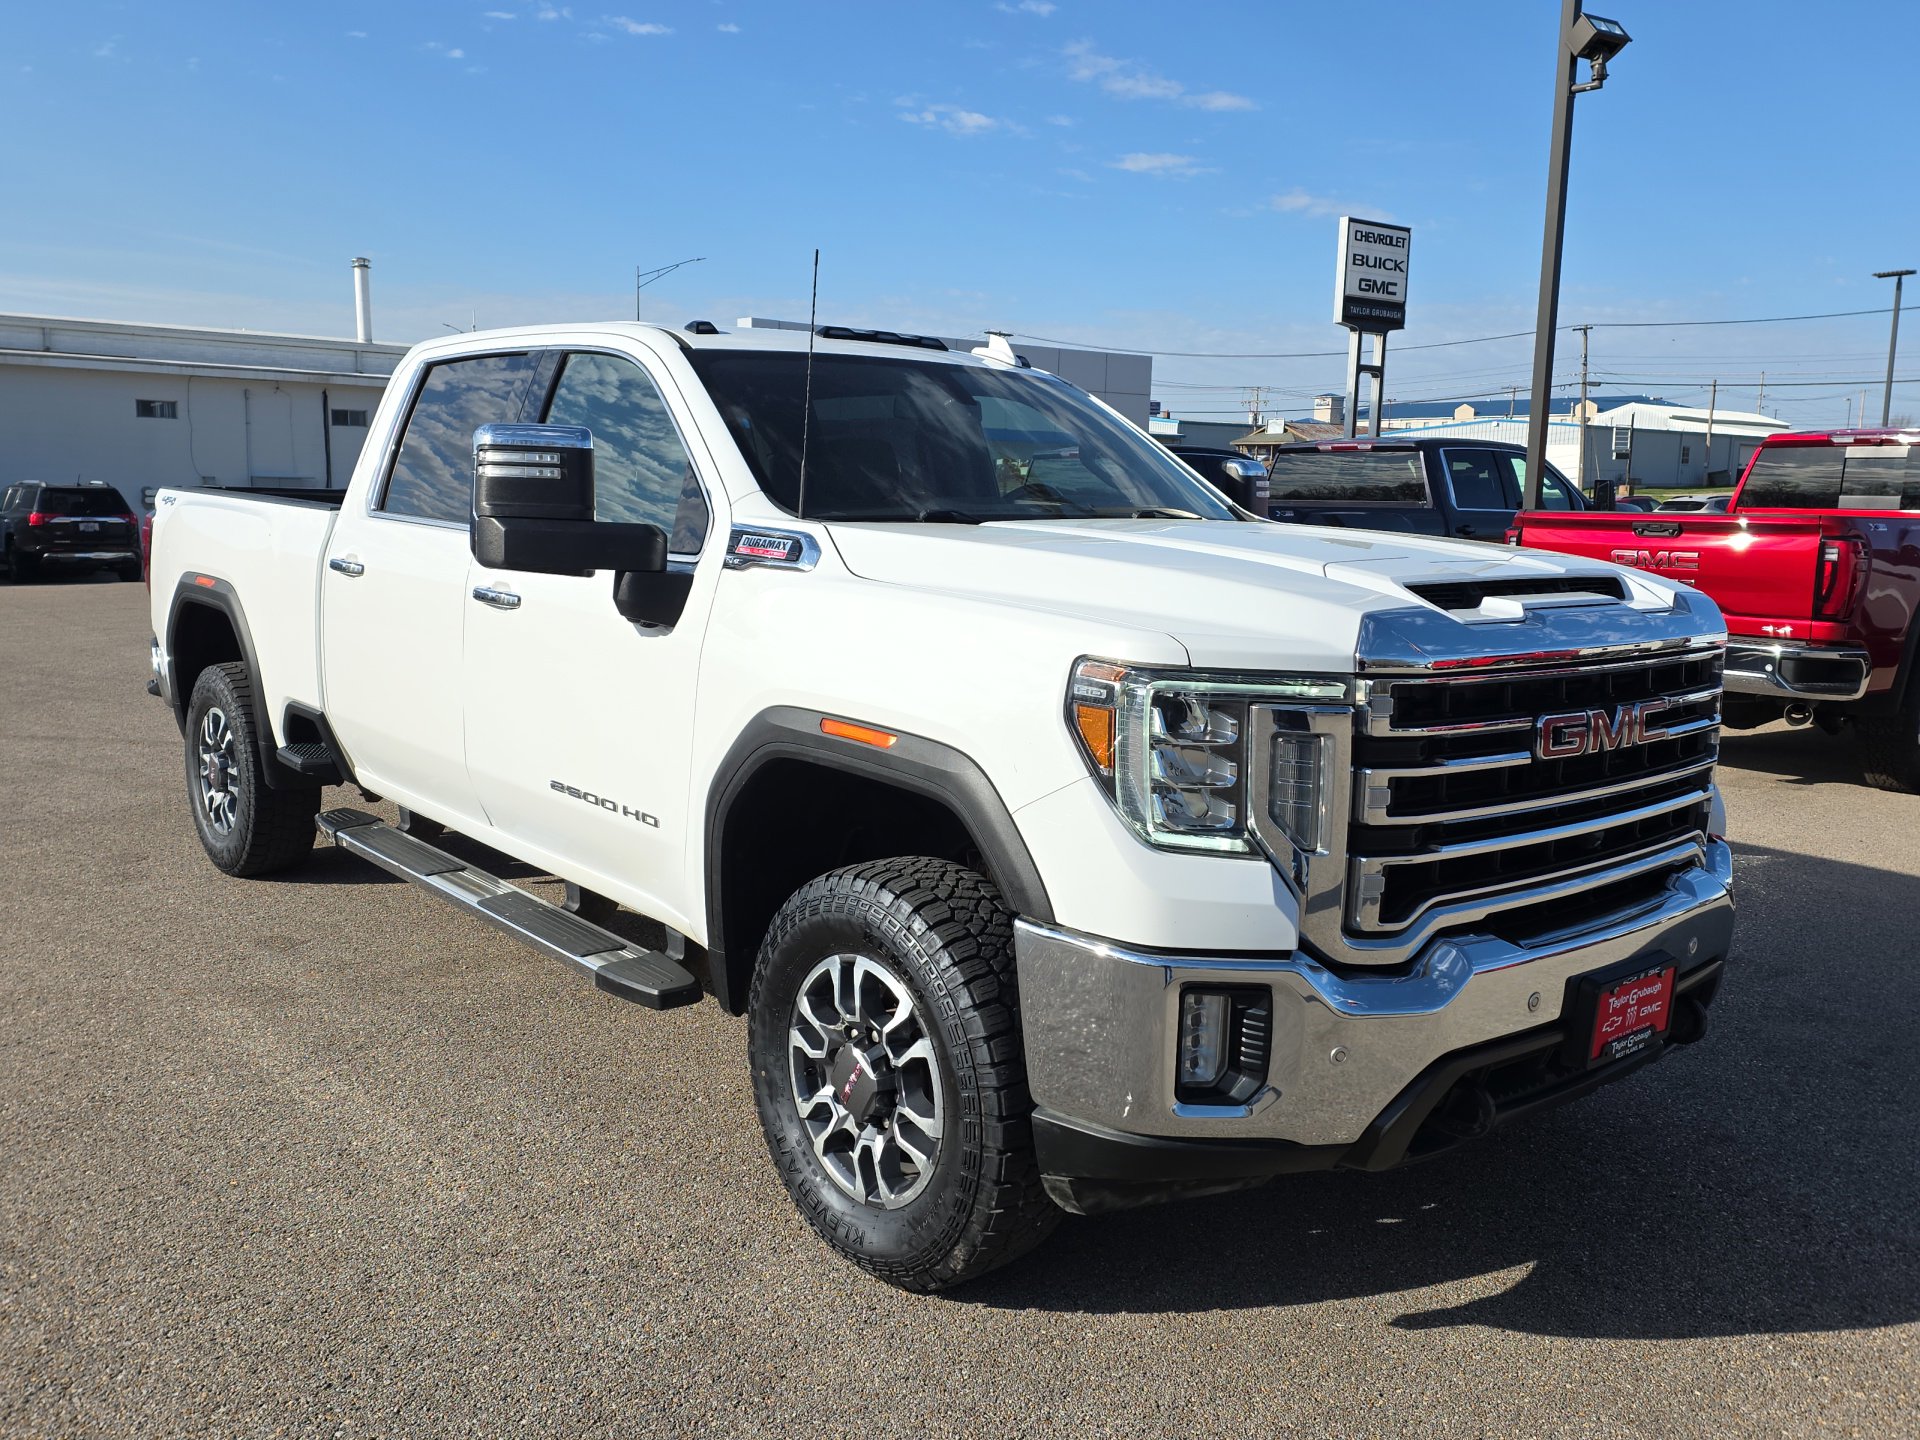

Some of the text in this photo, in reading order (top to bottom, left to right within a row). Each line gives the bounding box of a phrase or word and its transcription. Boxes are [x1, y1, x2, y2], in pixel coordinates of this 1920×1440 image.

[1354, 229, 1407, 248] CHEVROLET
[1352, 253, 1405, 273] BUICK
[1358, 278, 1398, 296] GMC
[1350, 306, 1402, 319] TAYLOR GRUBAUGH
[742, 536, 789, 551] DURAMAX
[1611, 549, 1699, 569] GMC
[1536, 700, 1668, 760] GMC
[550, 780, 660, 828] 2500 HD
[1609, 982, 1662, 1013] Taylor Grubaugh
[1640, 1002, 1662, 1016] GMC
[1612, 1030, 1652, 1054] Taylor Grubaugh
[797, 1177, 866, 1248] KLEVER
